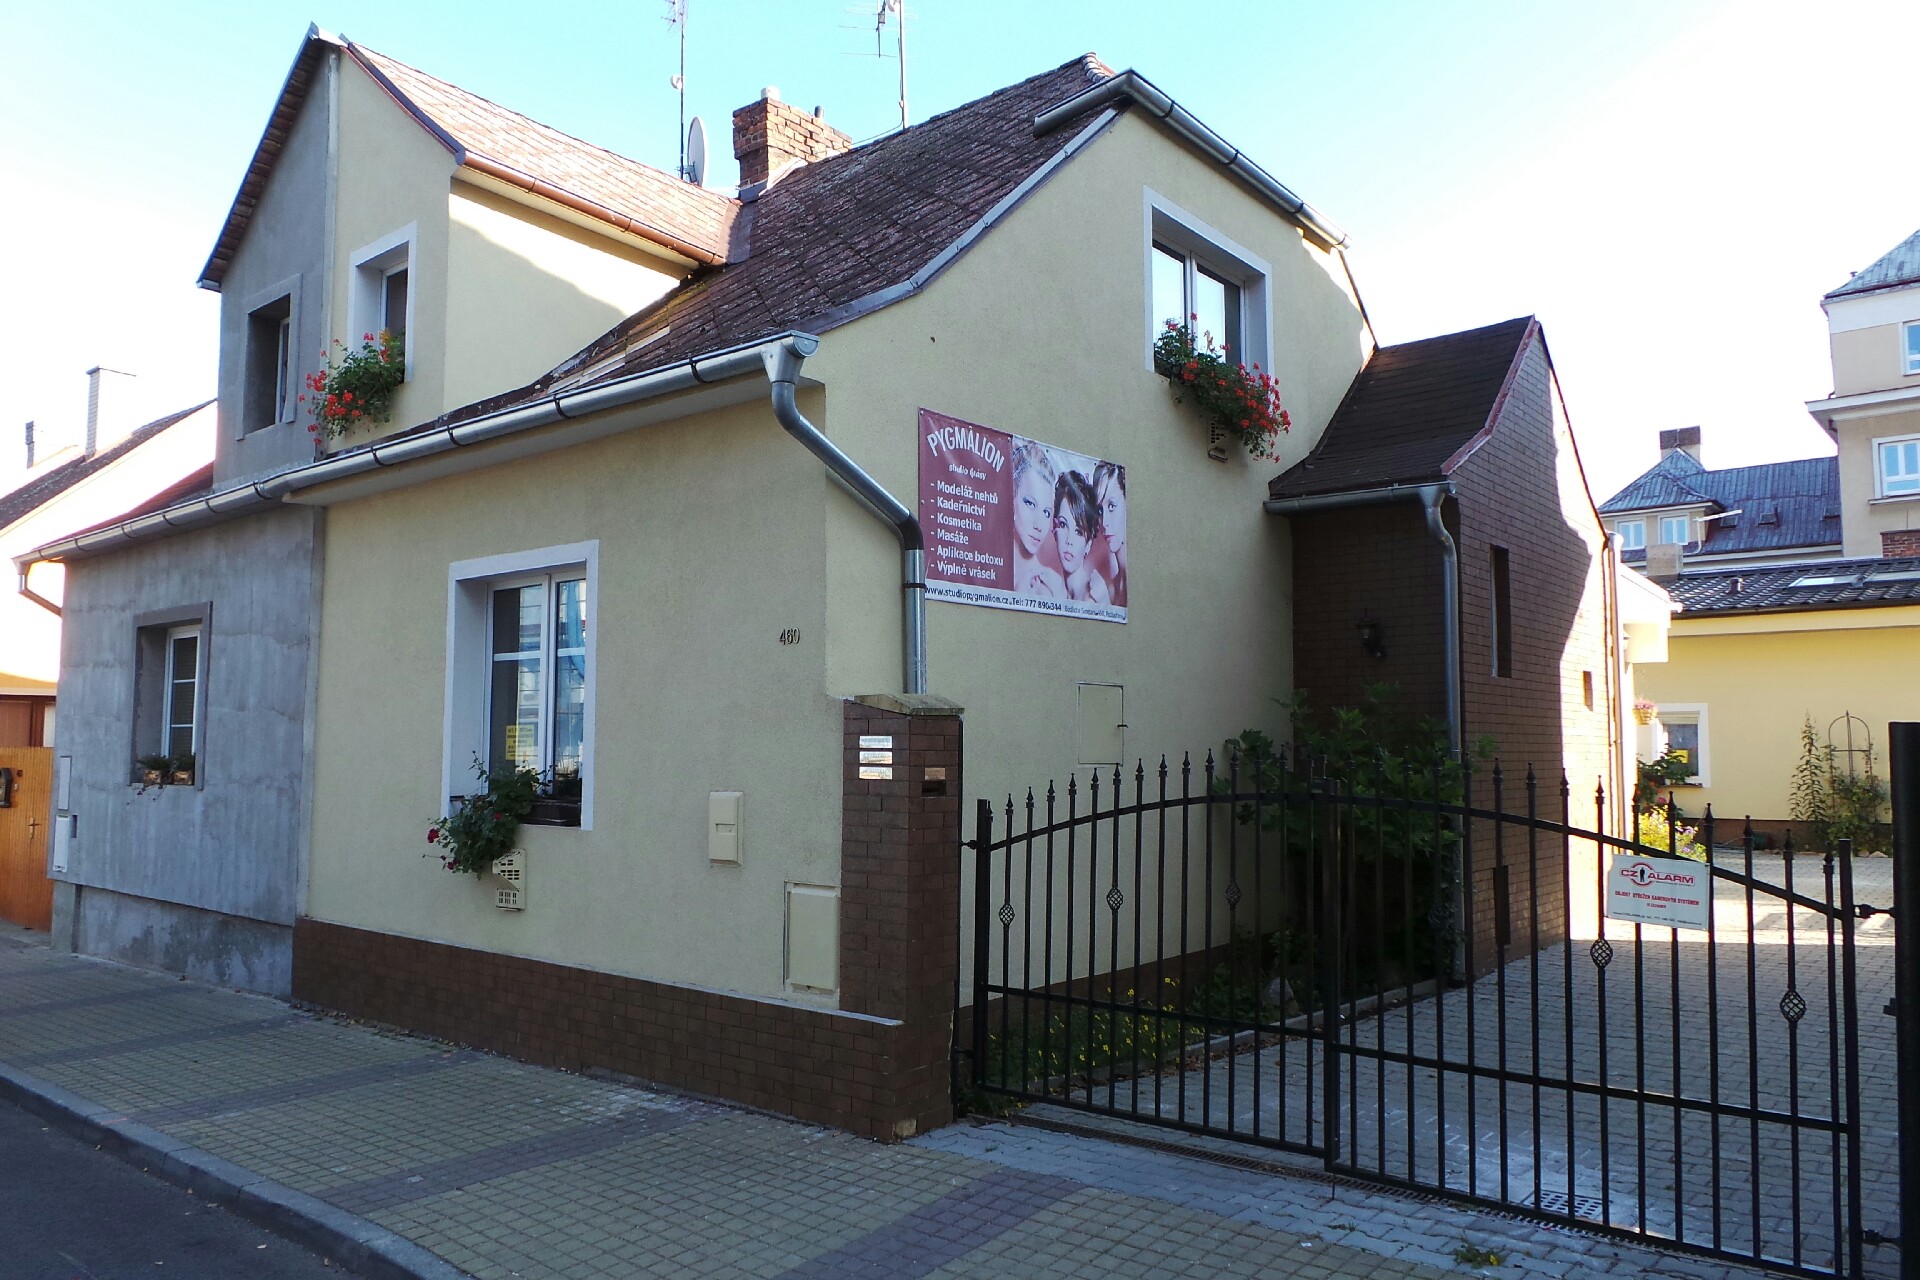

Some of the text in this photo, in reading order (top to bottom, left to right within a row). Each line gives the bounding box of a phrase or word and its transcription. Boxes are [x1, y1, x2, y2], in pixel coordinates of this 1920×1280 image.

[937, 480, 999, 504] Modeláž nehtů
[937, 496, 986, 517] Kadeřnictví
[937, 512, 982, 531] Kosmetika
[937, 528, 969, 545] Masáže
[936, 544, 1004, 567] Aplikace botoxu
[936, 560, 997, 581] Výplně vrásek
[1025, 599, 1037, 608] 777
[779, 627, 800, 645] 460
[1621, 869, 1638, 877] CZ
[1647, 872, 1694, 884] ALARM
